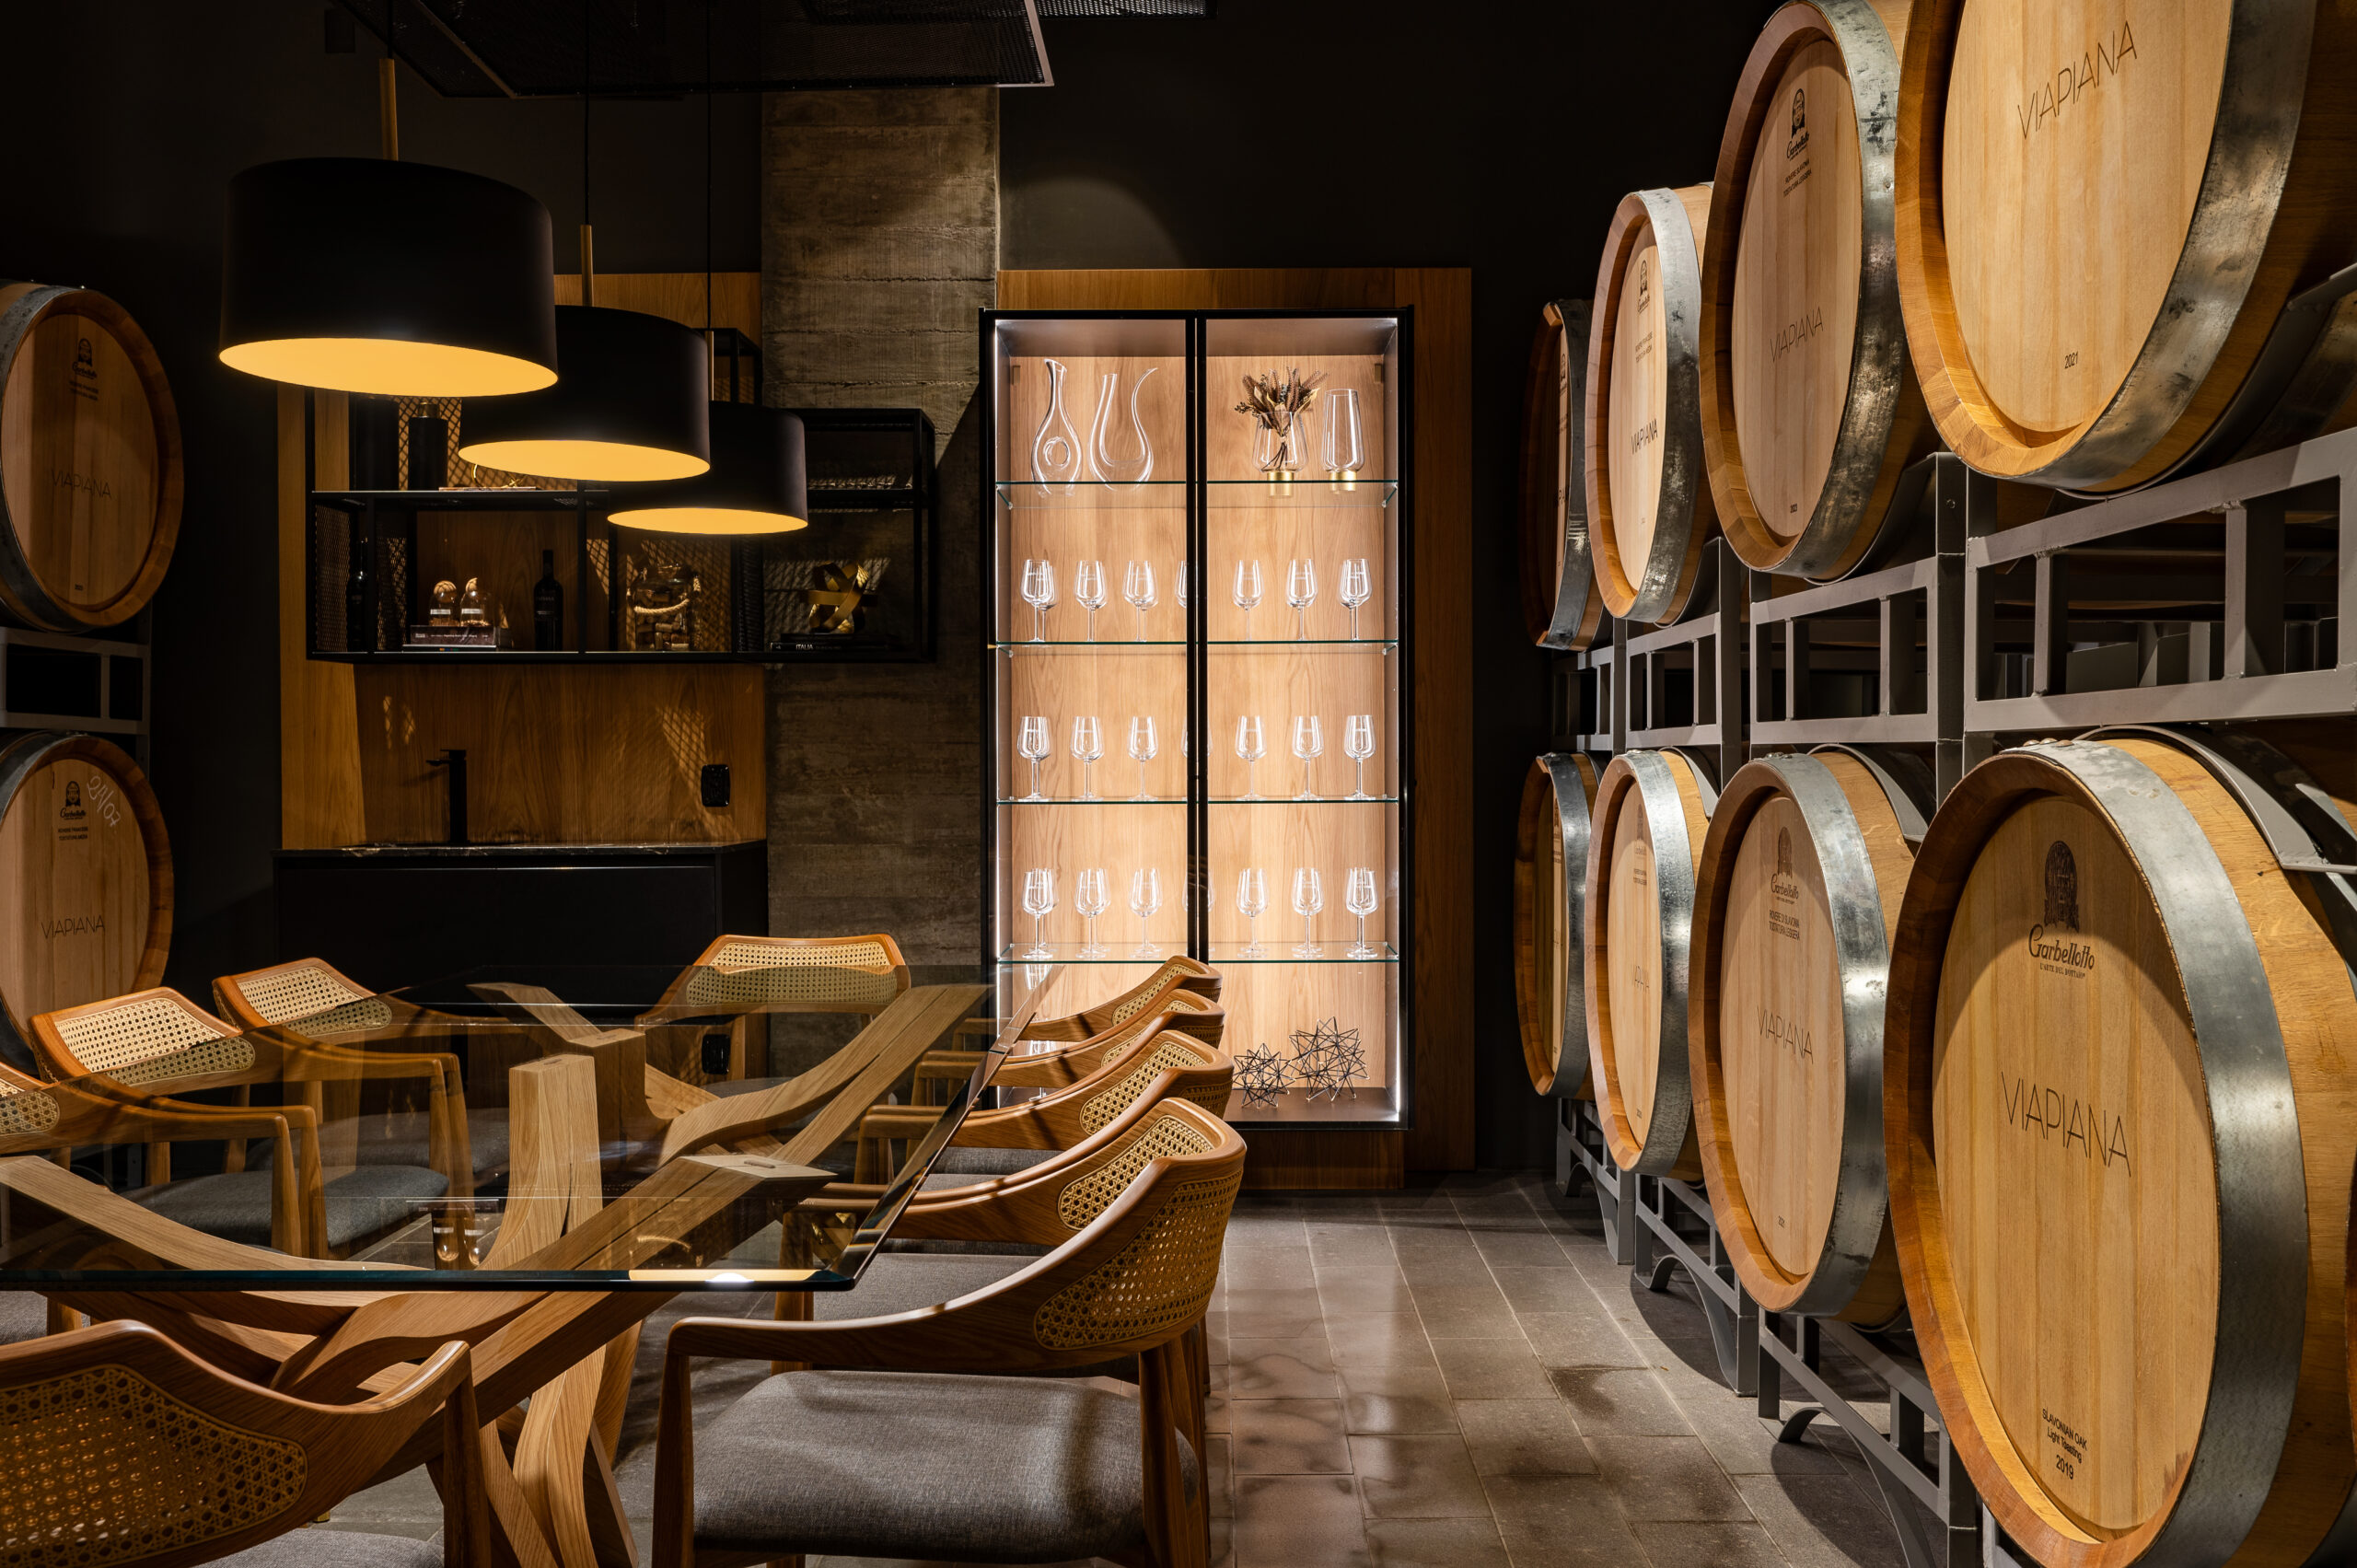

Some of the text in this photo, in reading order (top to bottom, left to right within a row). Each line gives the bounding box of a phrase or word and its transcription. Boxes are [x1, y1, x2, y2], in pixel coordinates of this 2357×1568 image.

[2016, 19, 2138, 140] VIAPIANA
[1769, 305, 1824, 363] VIAPIANA
[2064, 350, 2079, 369] 2021
[1631, 418, 1658, 455] VIAPIANA
[51, 468, 112, 500] VIAPIANA
[795, 643, 814, 651] ITALIA
[1771, 873, 1799, 900] Garbellotto
[41, 914, 106, 939] VIAPIANA
[2028, 923, 2095, 970] Garbellotto
[1757, 1005, 1814, 1065] VIAPIANA
[2001, 1070, 2131, 1179] VIAPIANA
[2042, 1408, 2088, 1451] SLAVONIAN OAK
[2047, 1426, 2083, 1464] Light Toasting
[2056, 1454, 2073, 1480] 2019
